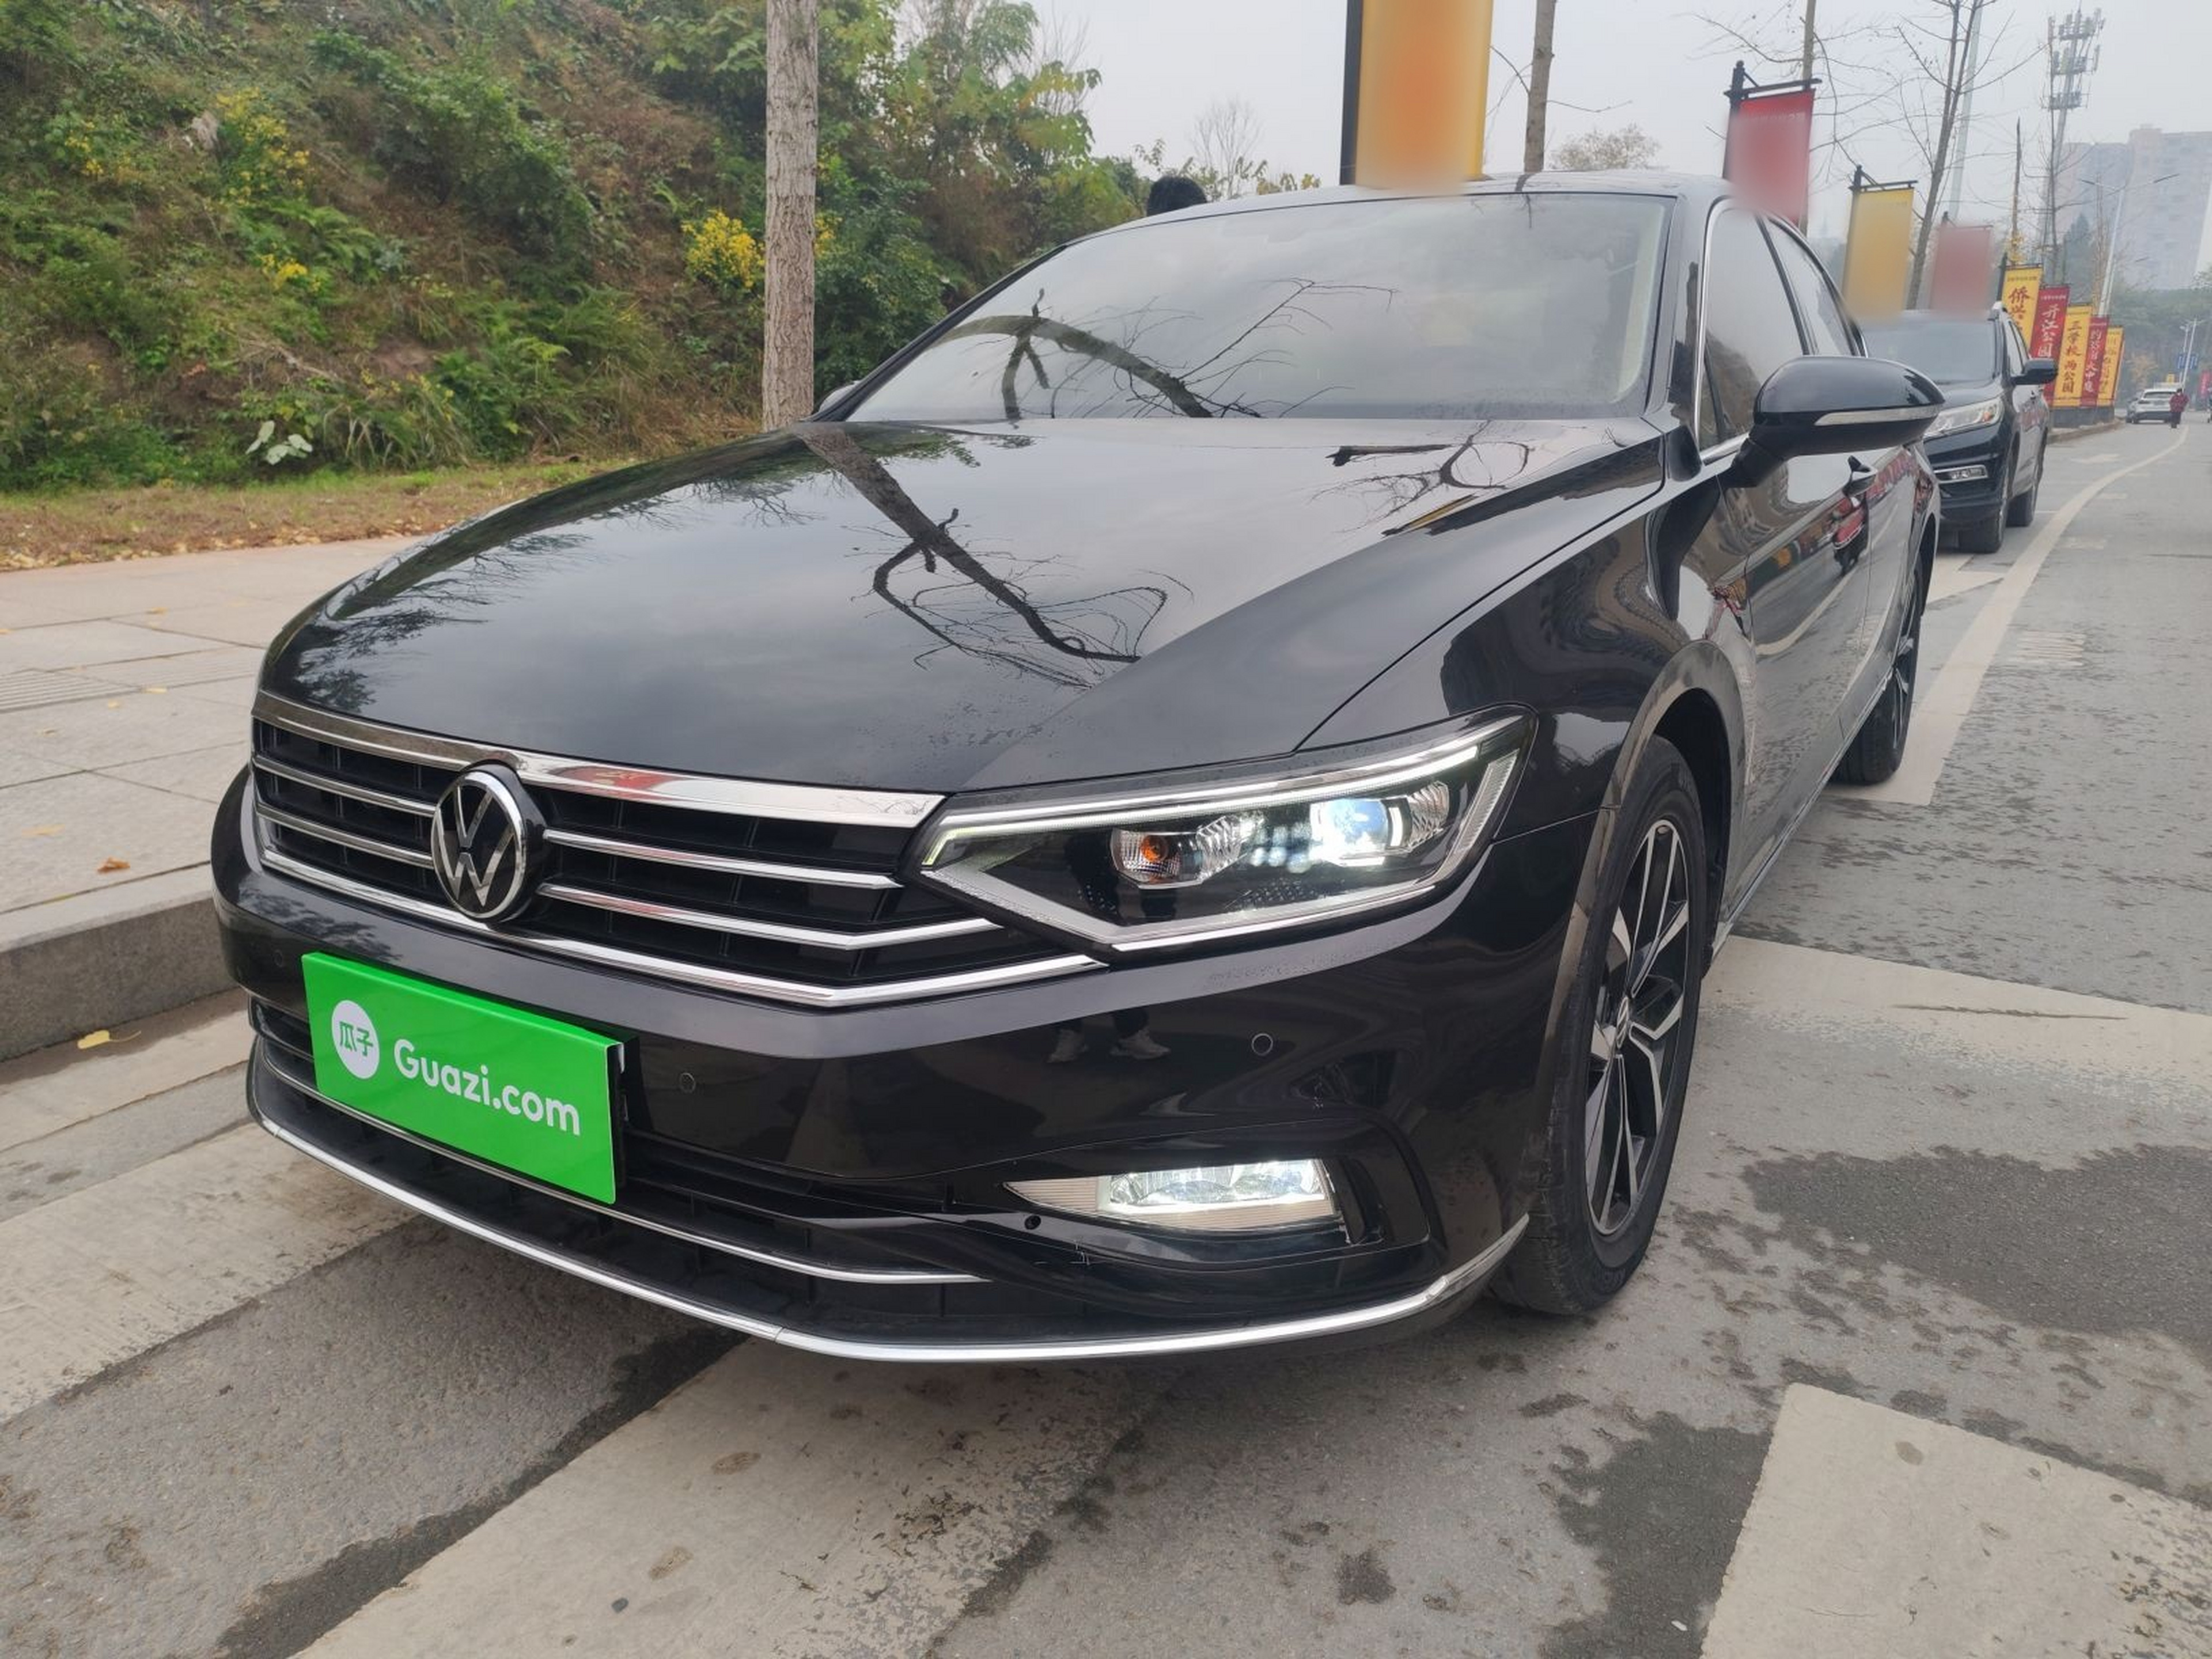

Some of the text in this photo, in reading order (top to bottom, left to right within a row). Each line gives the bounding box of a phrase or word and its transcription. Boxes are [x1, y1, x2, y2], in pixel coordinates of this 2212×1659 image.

[2038, 304, 2060, 357] 开江公园
[339, 1020, 374, 1057] 瓜子
[393, 1038, 581, 1137] Guazi.com
